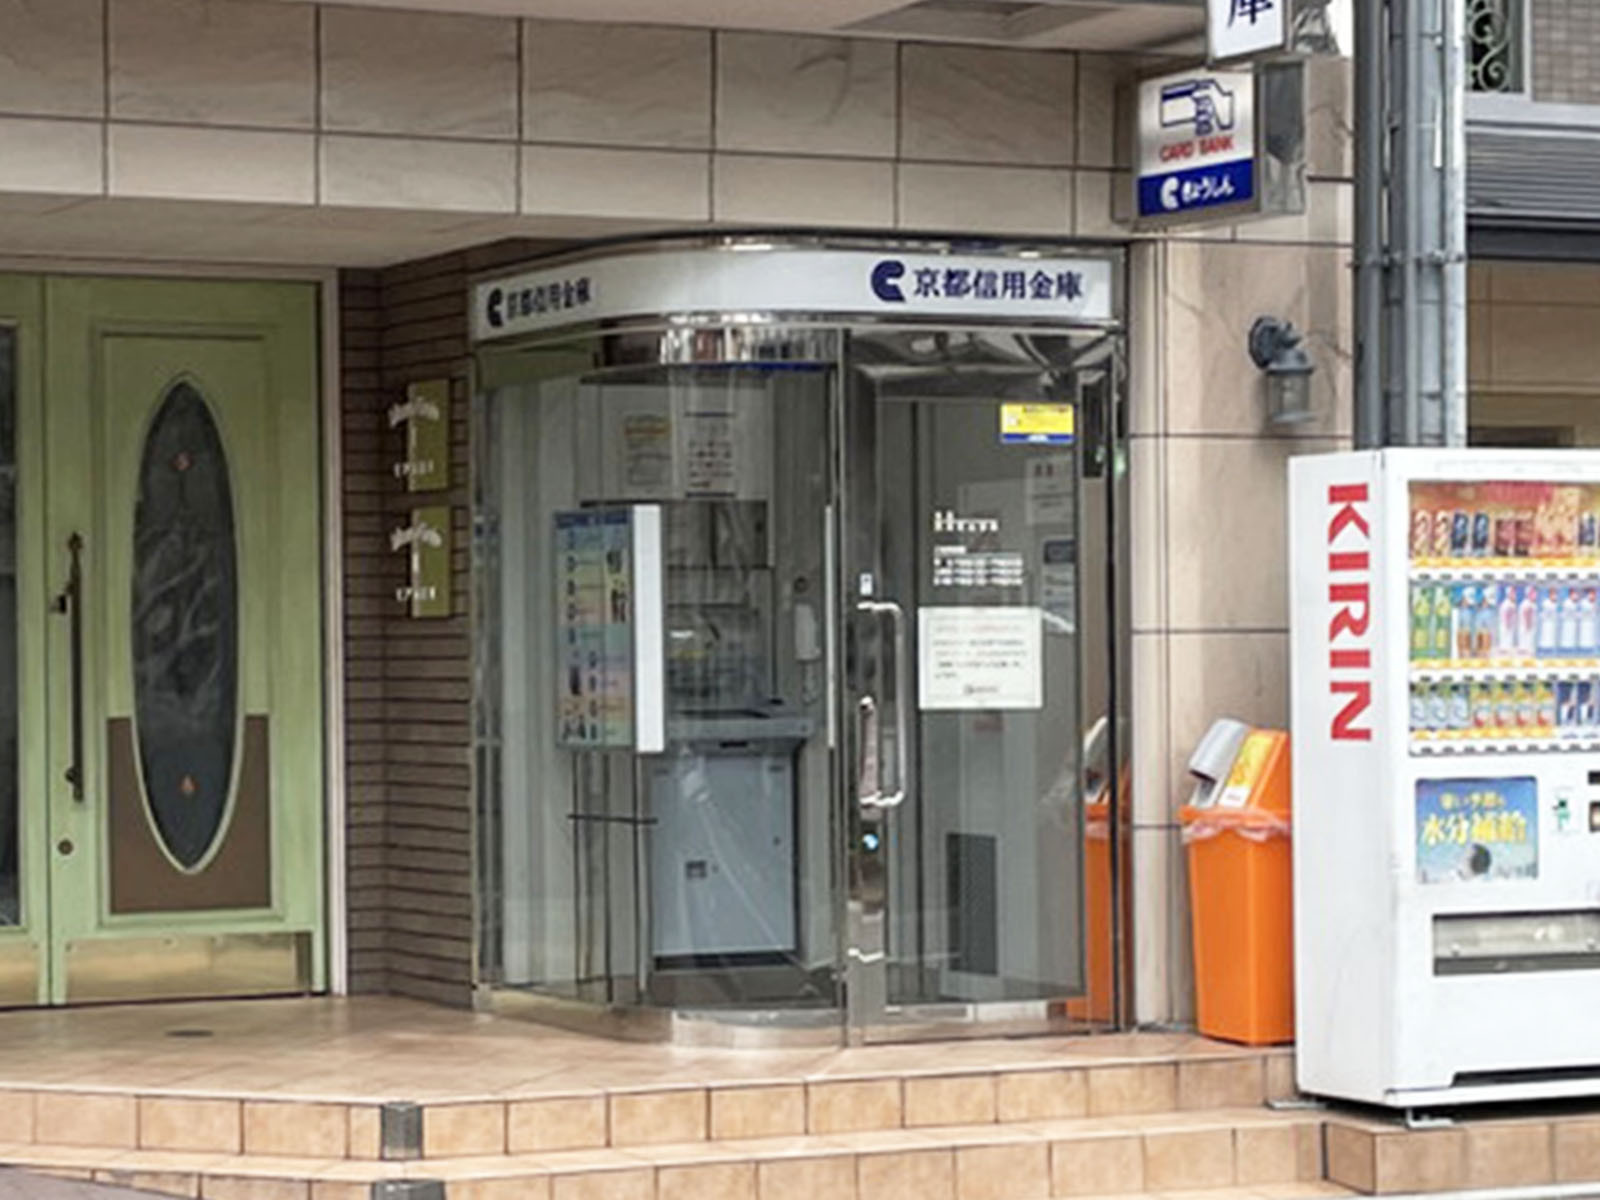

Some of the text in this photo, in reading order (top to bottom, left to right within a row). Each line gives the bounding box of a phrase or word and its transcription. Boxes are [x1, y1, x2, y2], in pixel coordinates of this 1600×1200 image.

[1160, 136, 1234, 162] CARD BANK
[913, 267, 1083, 301] 京都信用金庫
[1328, 482, 1371, 742] KIRIN
